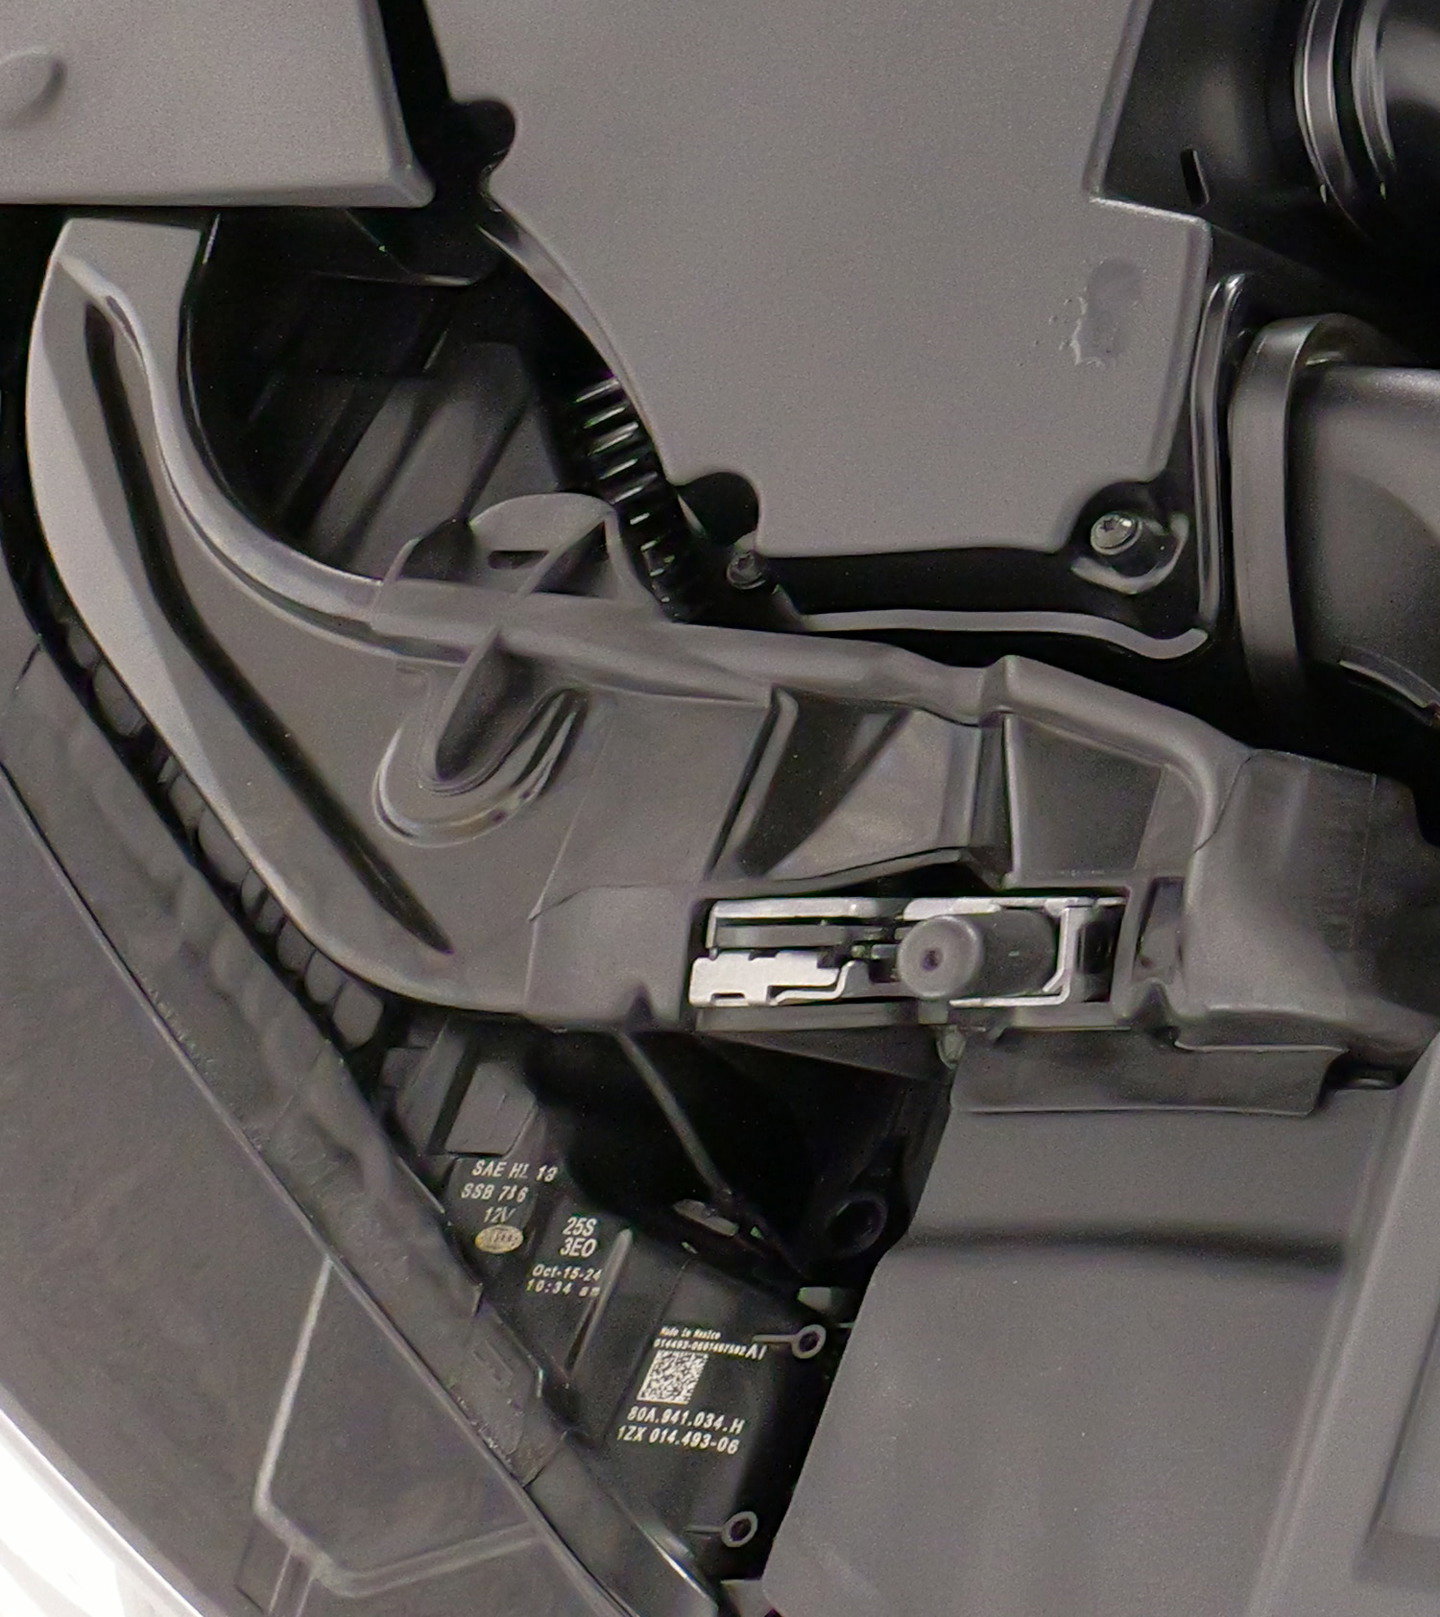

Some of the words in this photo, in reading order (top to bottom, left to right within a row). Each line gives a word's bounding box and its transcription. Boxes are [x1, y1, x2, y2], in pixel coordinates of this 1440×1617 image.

[472, 1160, 507, 1178] SAE
[508, 1162, 530, 1179] HL
[461, 1183, 494, 1200] SSB
[563, 1217, 597, 1236] 25S
[532, 1264, 602, 1281] Oct-15-24
[627, 1406, 745, 1435] 80A.941.034.H
[617, 1425, 647, 1442] 1ZX
[649, 1428, 740, 1455] 014.493-06
